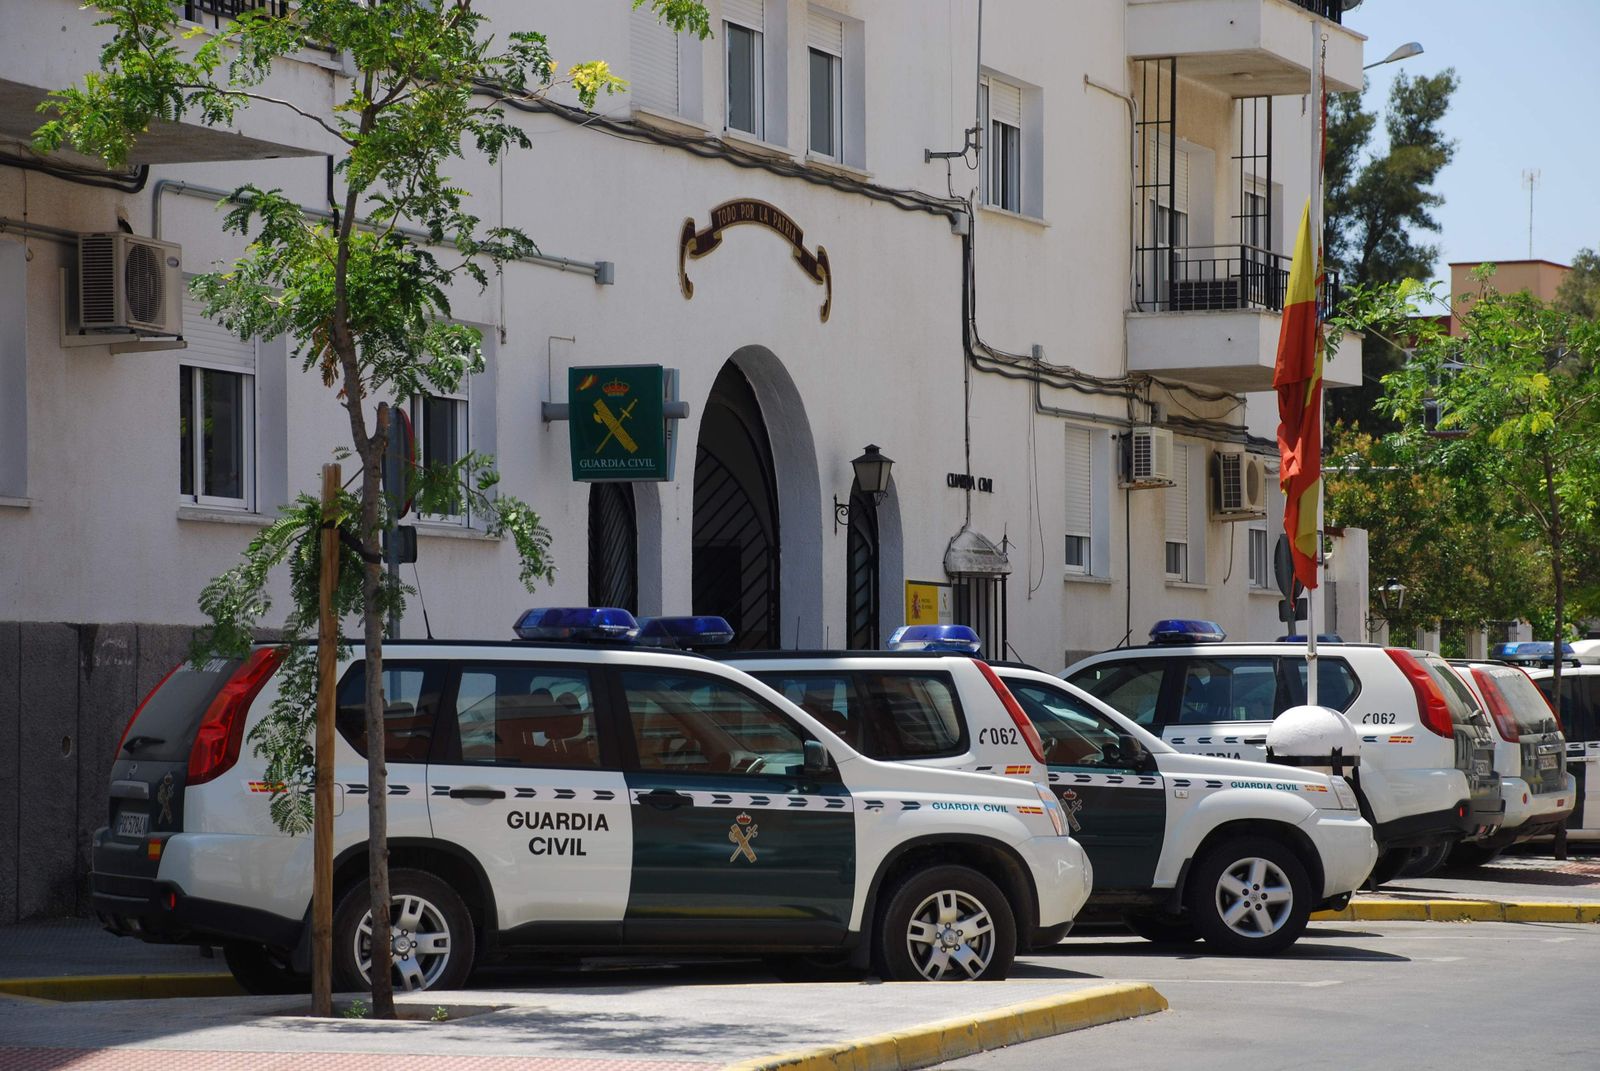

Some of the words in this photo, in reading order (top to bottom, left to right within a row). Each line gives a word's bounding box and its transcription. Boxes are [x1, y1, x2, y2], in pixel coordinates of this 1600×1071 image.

[717, 206, 737, 225] TODO
[740, 203, 755, 219] POR
[759, 206, 769, 224] LA
[773, 212, 796, 243] PATRIA
[579, 459, 626, 469] GUARDIA
[627, 458, 656, 468] CIVIL
[1372, 712, 1396, 725] 062
[990, 727, 1019, 745] 062
[1230, 781, 1273, 790] GUARDIA
[1275, 783, 1299, 792] CIVIL
[932, 801, 980, 812] GUARDIA
[983, 804, 1009, 814] CIVIL
[506, 810, 610, 832] GUARDIA
[528, 836, 587, 857] CIVIL
